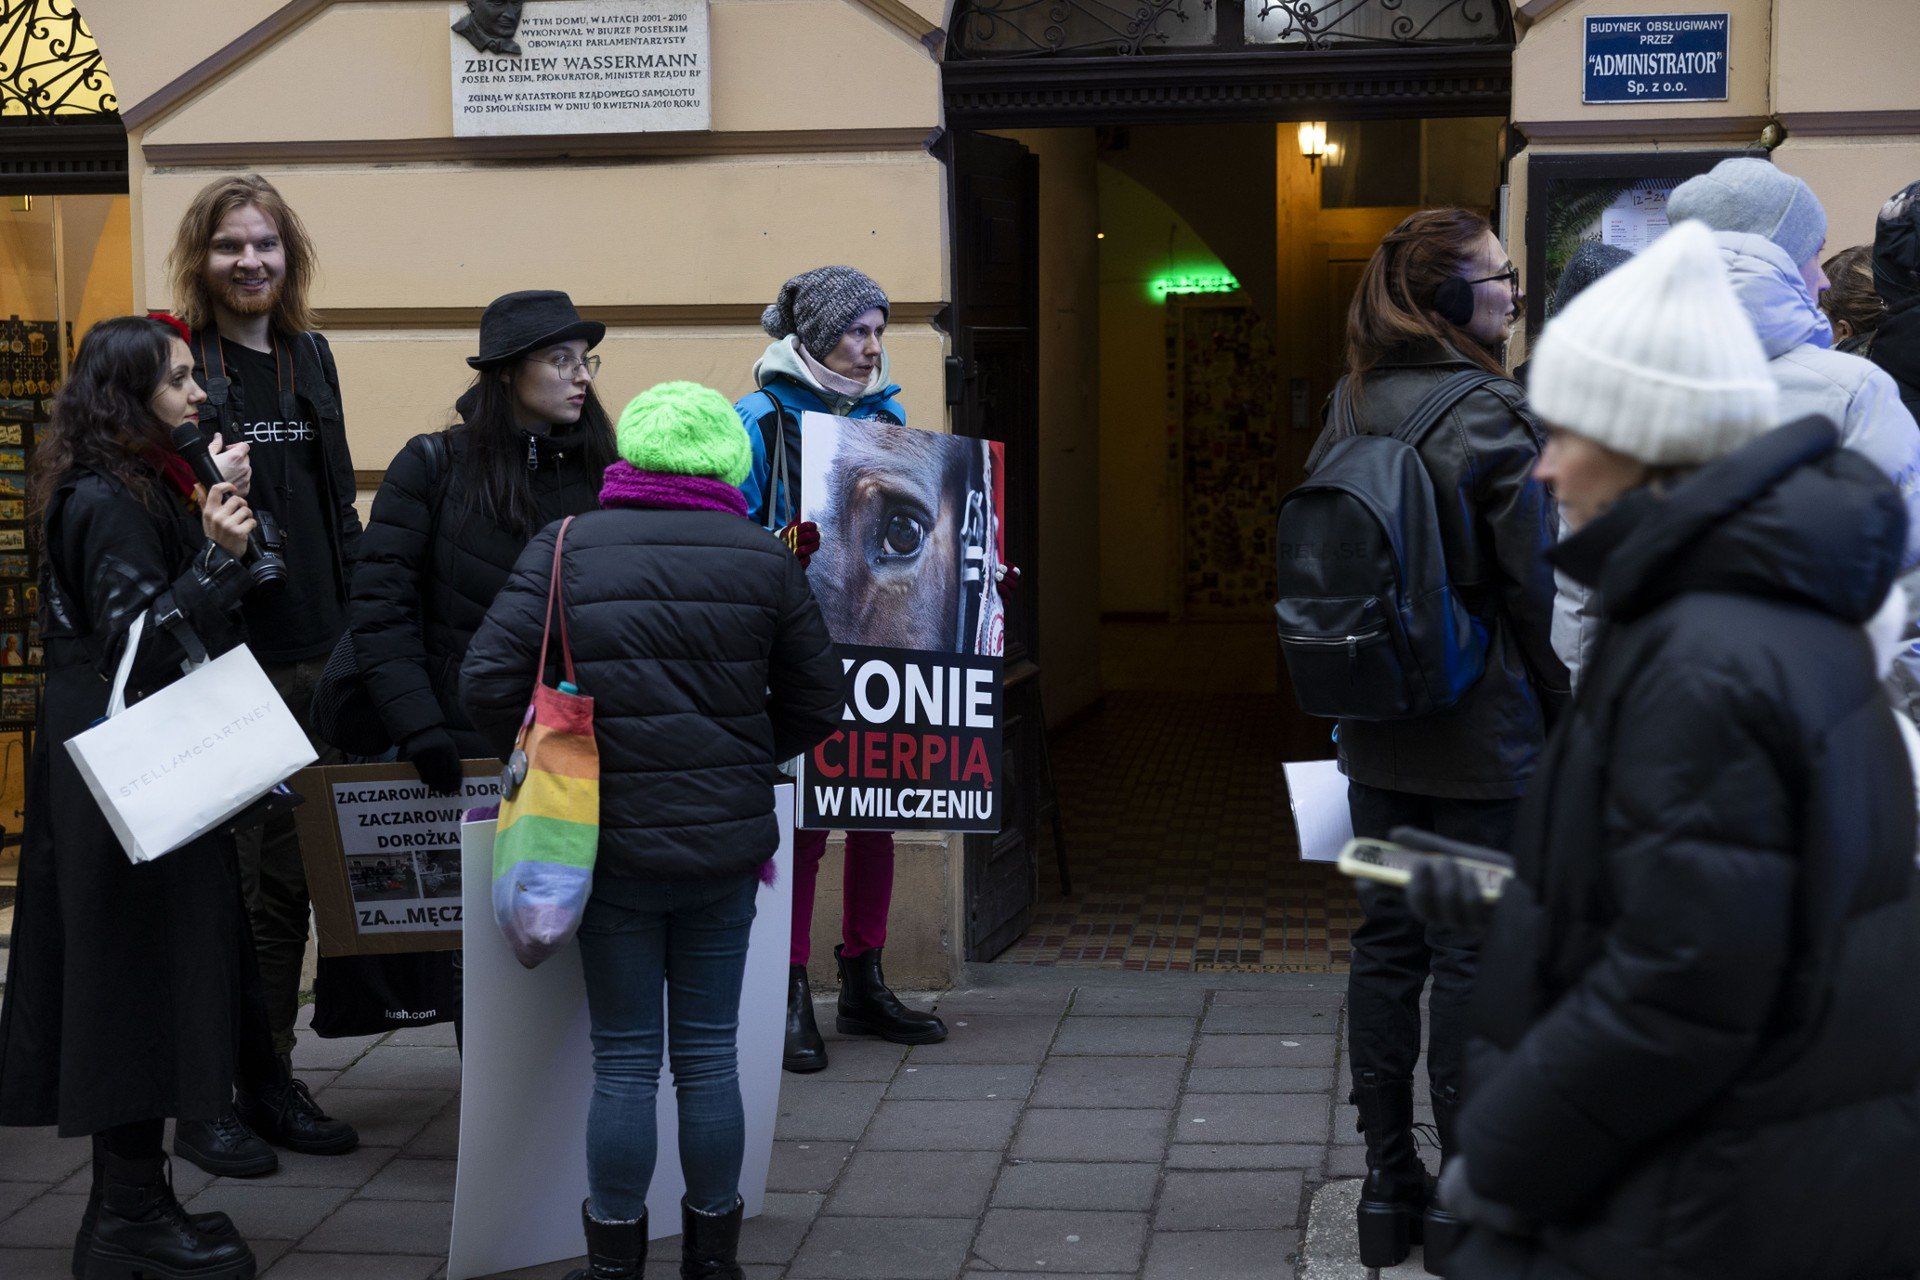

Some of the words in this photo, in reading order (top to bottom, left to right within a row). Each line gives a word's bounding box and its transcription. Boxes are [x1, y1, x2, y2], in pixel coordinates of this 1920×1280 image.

[532, 17, 553, 25] TYM
[555, 17, 588, 25] DOMU,
[590, 16, 600, 24] W
[642, 14, 661, 22] 2001
[521, 28, 583, 37] WYKONYWAŁ
[598, 26, 631, 35] BIURZE
[634, 25, 688, 34] POSELSKIM
[1590, 22, 1641, 33] BUDYNEK
[1646, 20, 1725, 32] OBSŁUGIWANY
[527, 40, 583, 49] OBOWIĄZKI
[586, 36, 686, 47] PARLAMENTARZYSTY
[1640, 34, 1674, 45] PRZEZ
[465, 58, 557, 73] ZBIGNIEW
[563, 54, 698, 70] WASSERMANN
[461, 76, 490, 84] POSEŁ
[492, 75, 506, 83] NA
[508, 74, 535, 83] SEJM,
[536, 71, 603, 82] PROKURATOR,
[605, 71, 651, 80] MINISTER
[653, 70, 687, 80] RZĄDU
[1627, 80, 1649, 95] Sp.
[1652, 83, 1660, 92] z
[1663, 82, 1688, 92] o.o.
[468, 94, 503, 103] ZGINĄŁ
[515, 91, 577, 101] KATASTROFIE
[579, 89, 640, 100] RZĄDOWEGO
[642, 88, 695, 97] SAMOLOTU
[463, 105, 483, 113] POD
[485, 102, 552, 113] SMOLEŃSKIEM
[565, 102, 590, 110] DNIU
[603, 101, 651, 109] KWIETNIA
[653, 100, 672, 108] 2010
[673, 100, 700, 108] ROKU
[814, 730, 993, 789] CIERPIĄ
[466, 783, 503, 797] DOR
[814, 785, 845, 816] W
[850, 786, 993, 819] MILCZENIU
[385, 1009, 436, 1019] lush.com
